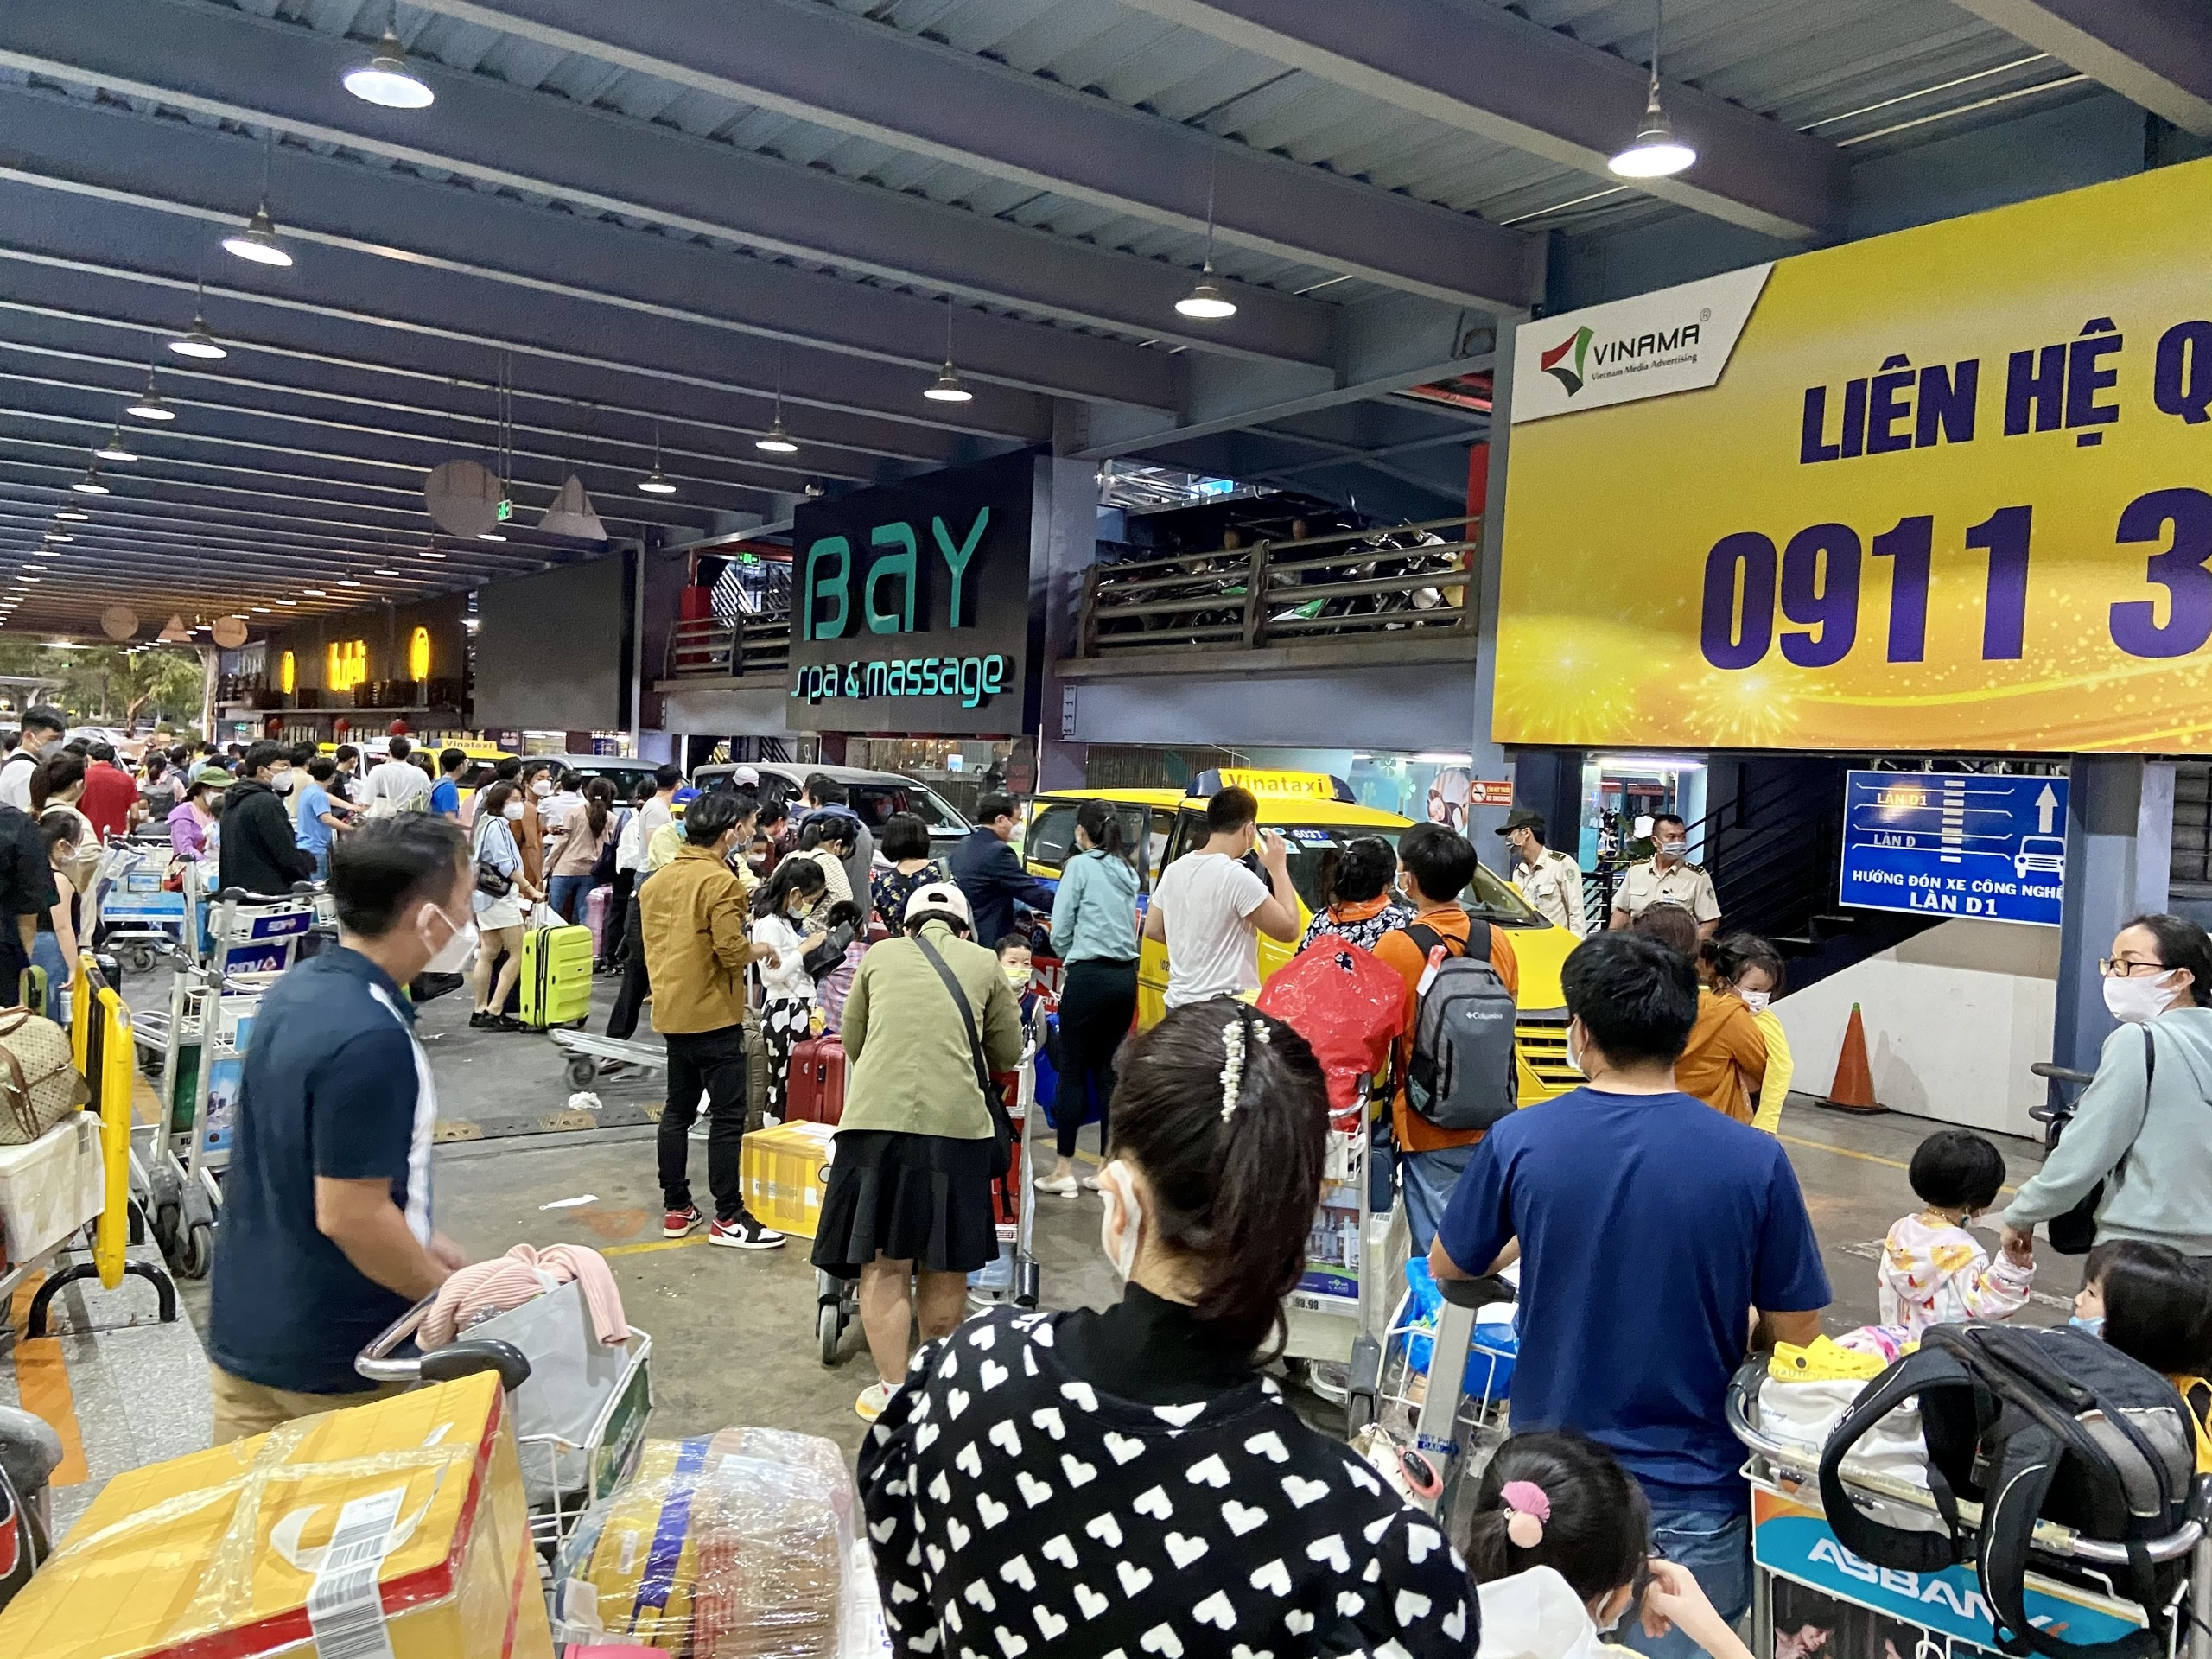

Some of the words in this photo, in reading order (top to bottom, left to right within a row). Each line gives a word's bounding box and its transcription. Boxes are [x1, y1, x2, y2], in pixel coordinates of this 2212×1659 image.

[1593, 323, 1700, 365] VINAMA
[1592, 369, 1623, 381] Vietnam
[1624, 363, 1649, 374] Media
[1650, 353, 1698, 369] Advertising
[1800, 354, 1980, 465] LIÊN
[2003, 316, 2124, 448] HỆ
[1700, 505, 2034, 671] 0911
[2109, 486, 2212, 659] 3
[790, 664, 839, 705] spa
[844, 661, 860, 699] &
[866, 654, 1004, 709] massage
[446, 740, 493, 750] Vinataxi
[1228, 773, 1324, 793] Vinataxi
[1877, 790, 1904, 805] LÀN
[1293, 830, 1323, 839] 6037
[1873, 831, 1902, 847] LÀN
[1906, 836, 1916, 848] D
[1908, 873, 1942, 889] ĐÓN
[1945, 878, 1967, 891] XE
[1971, 878, 2017, 895] CÔNG
[1910, 889, 1957, 912] LÀN
[1966, 896, 1998, 916] D1
